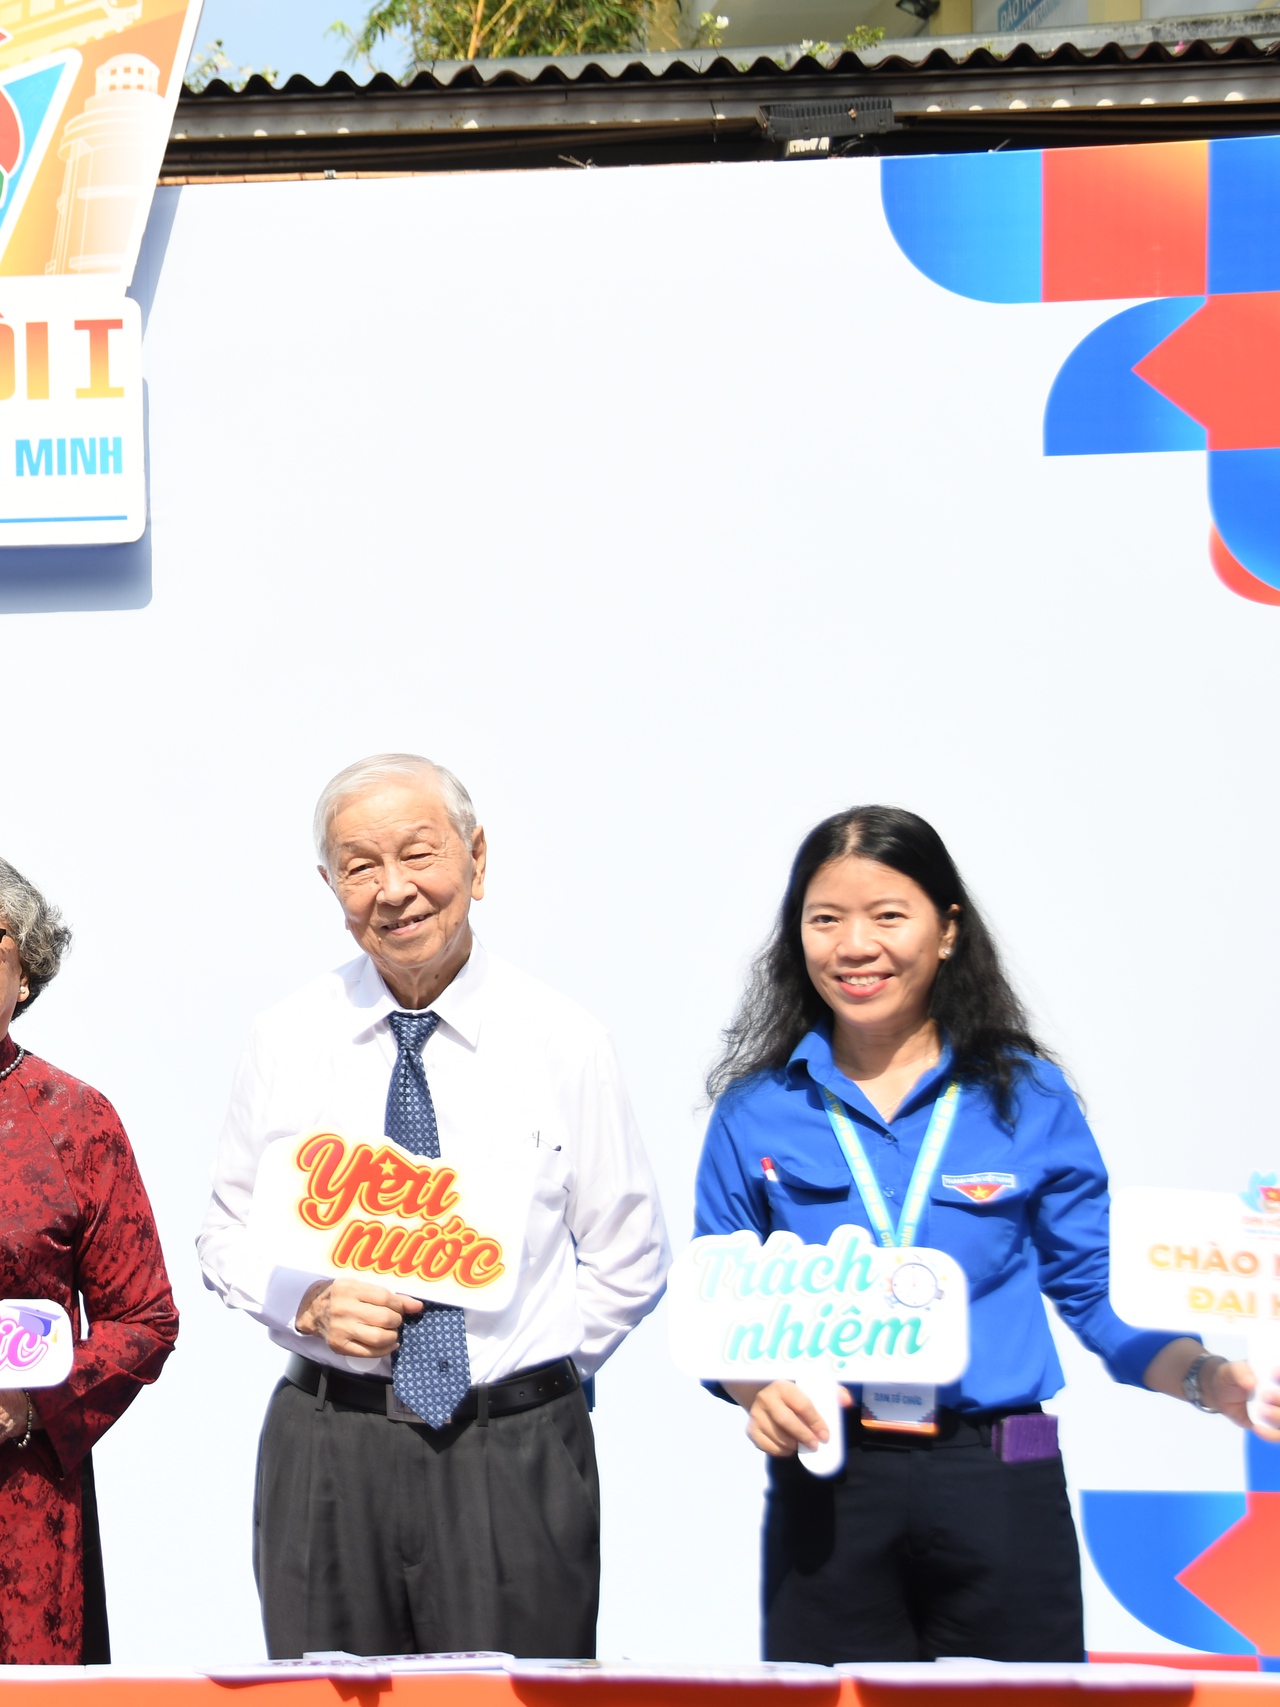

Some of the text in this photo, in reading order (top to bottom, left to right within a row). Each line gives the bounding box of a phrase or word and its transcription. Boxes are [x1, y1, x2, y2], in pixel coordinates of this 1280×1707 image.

[74, 318, 125, 399] I
[15, 437, 123, 477] MINH
[296, 1133, 460, 1231] Yêu
[332, 1215, 505, 1288] nước
[696, 1236, 880, 1300] Trách
[1149, 1242, 1260, 1276] CHÀO
[726, 1302, 930, 1369] nhiệm
[1188, 1287, 1257, 1321] ĐẠI
